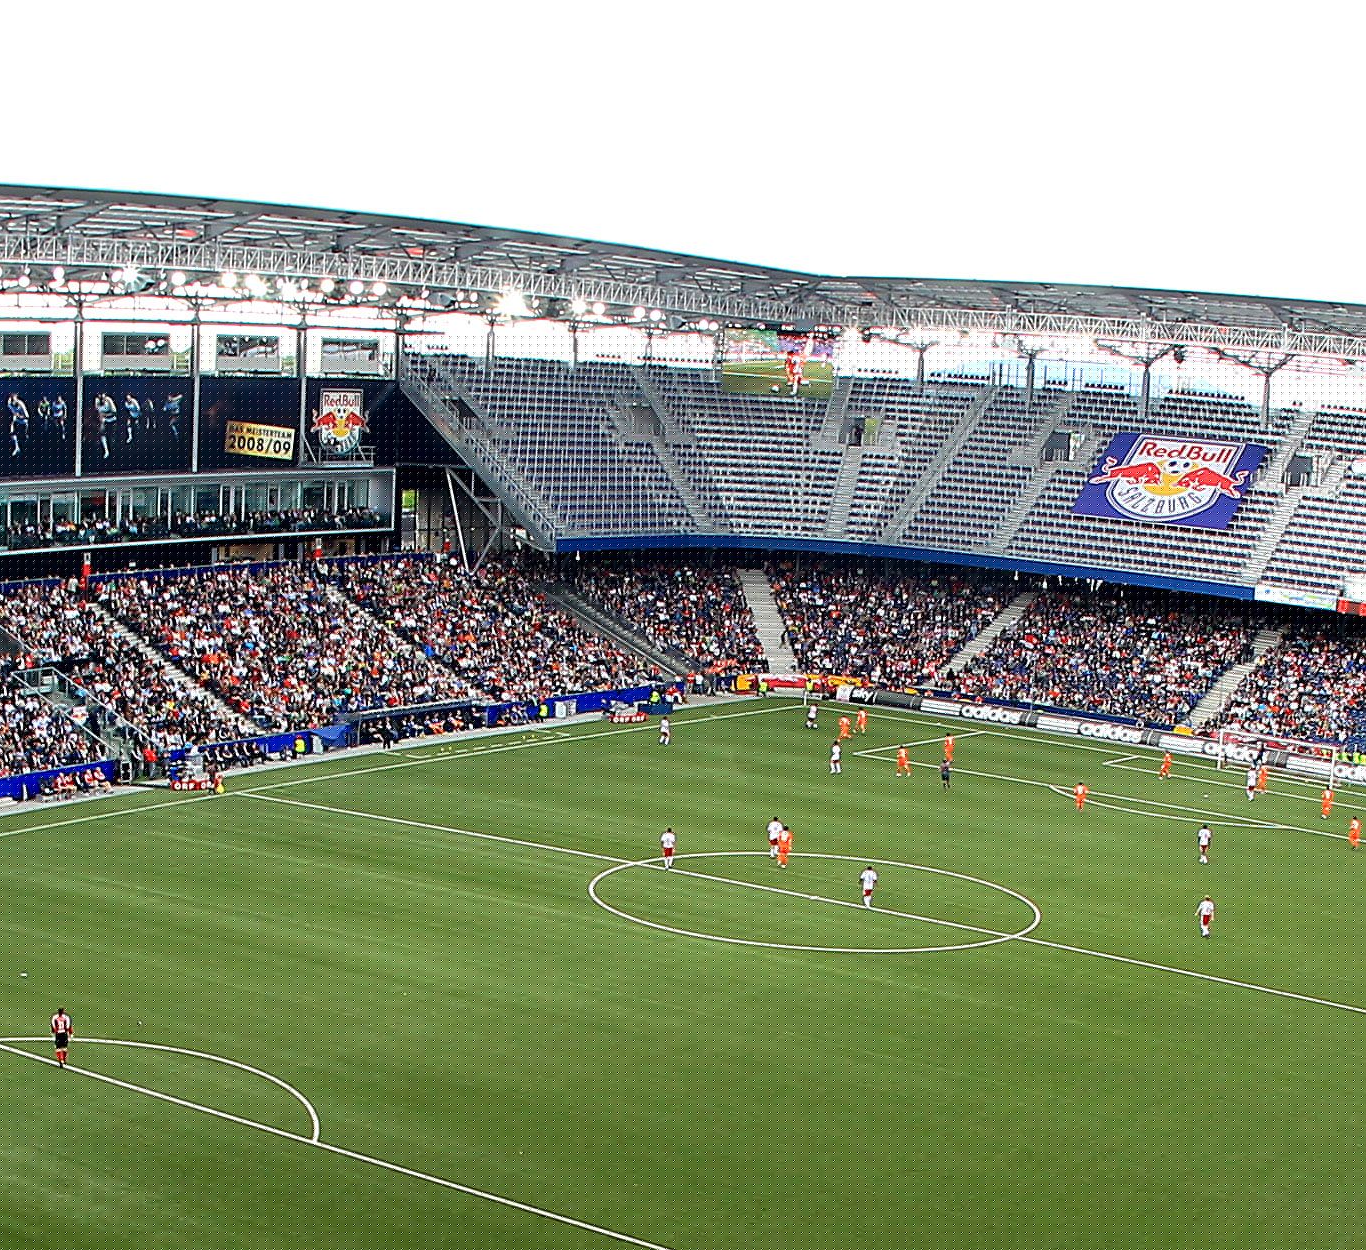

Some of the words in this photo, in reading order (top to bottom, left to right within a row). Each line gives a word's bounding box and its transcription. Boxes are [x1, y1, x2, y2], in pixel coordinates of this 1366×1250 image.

[229, 435, 291, 455] 2008/09
[1118, 487, 1202, 514] SALZBURG
[852, 687, 873, 702] sky
[961, 705, 1022, 725] adidas
[1080, 721, 1143, 743] adidas
